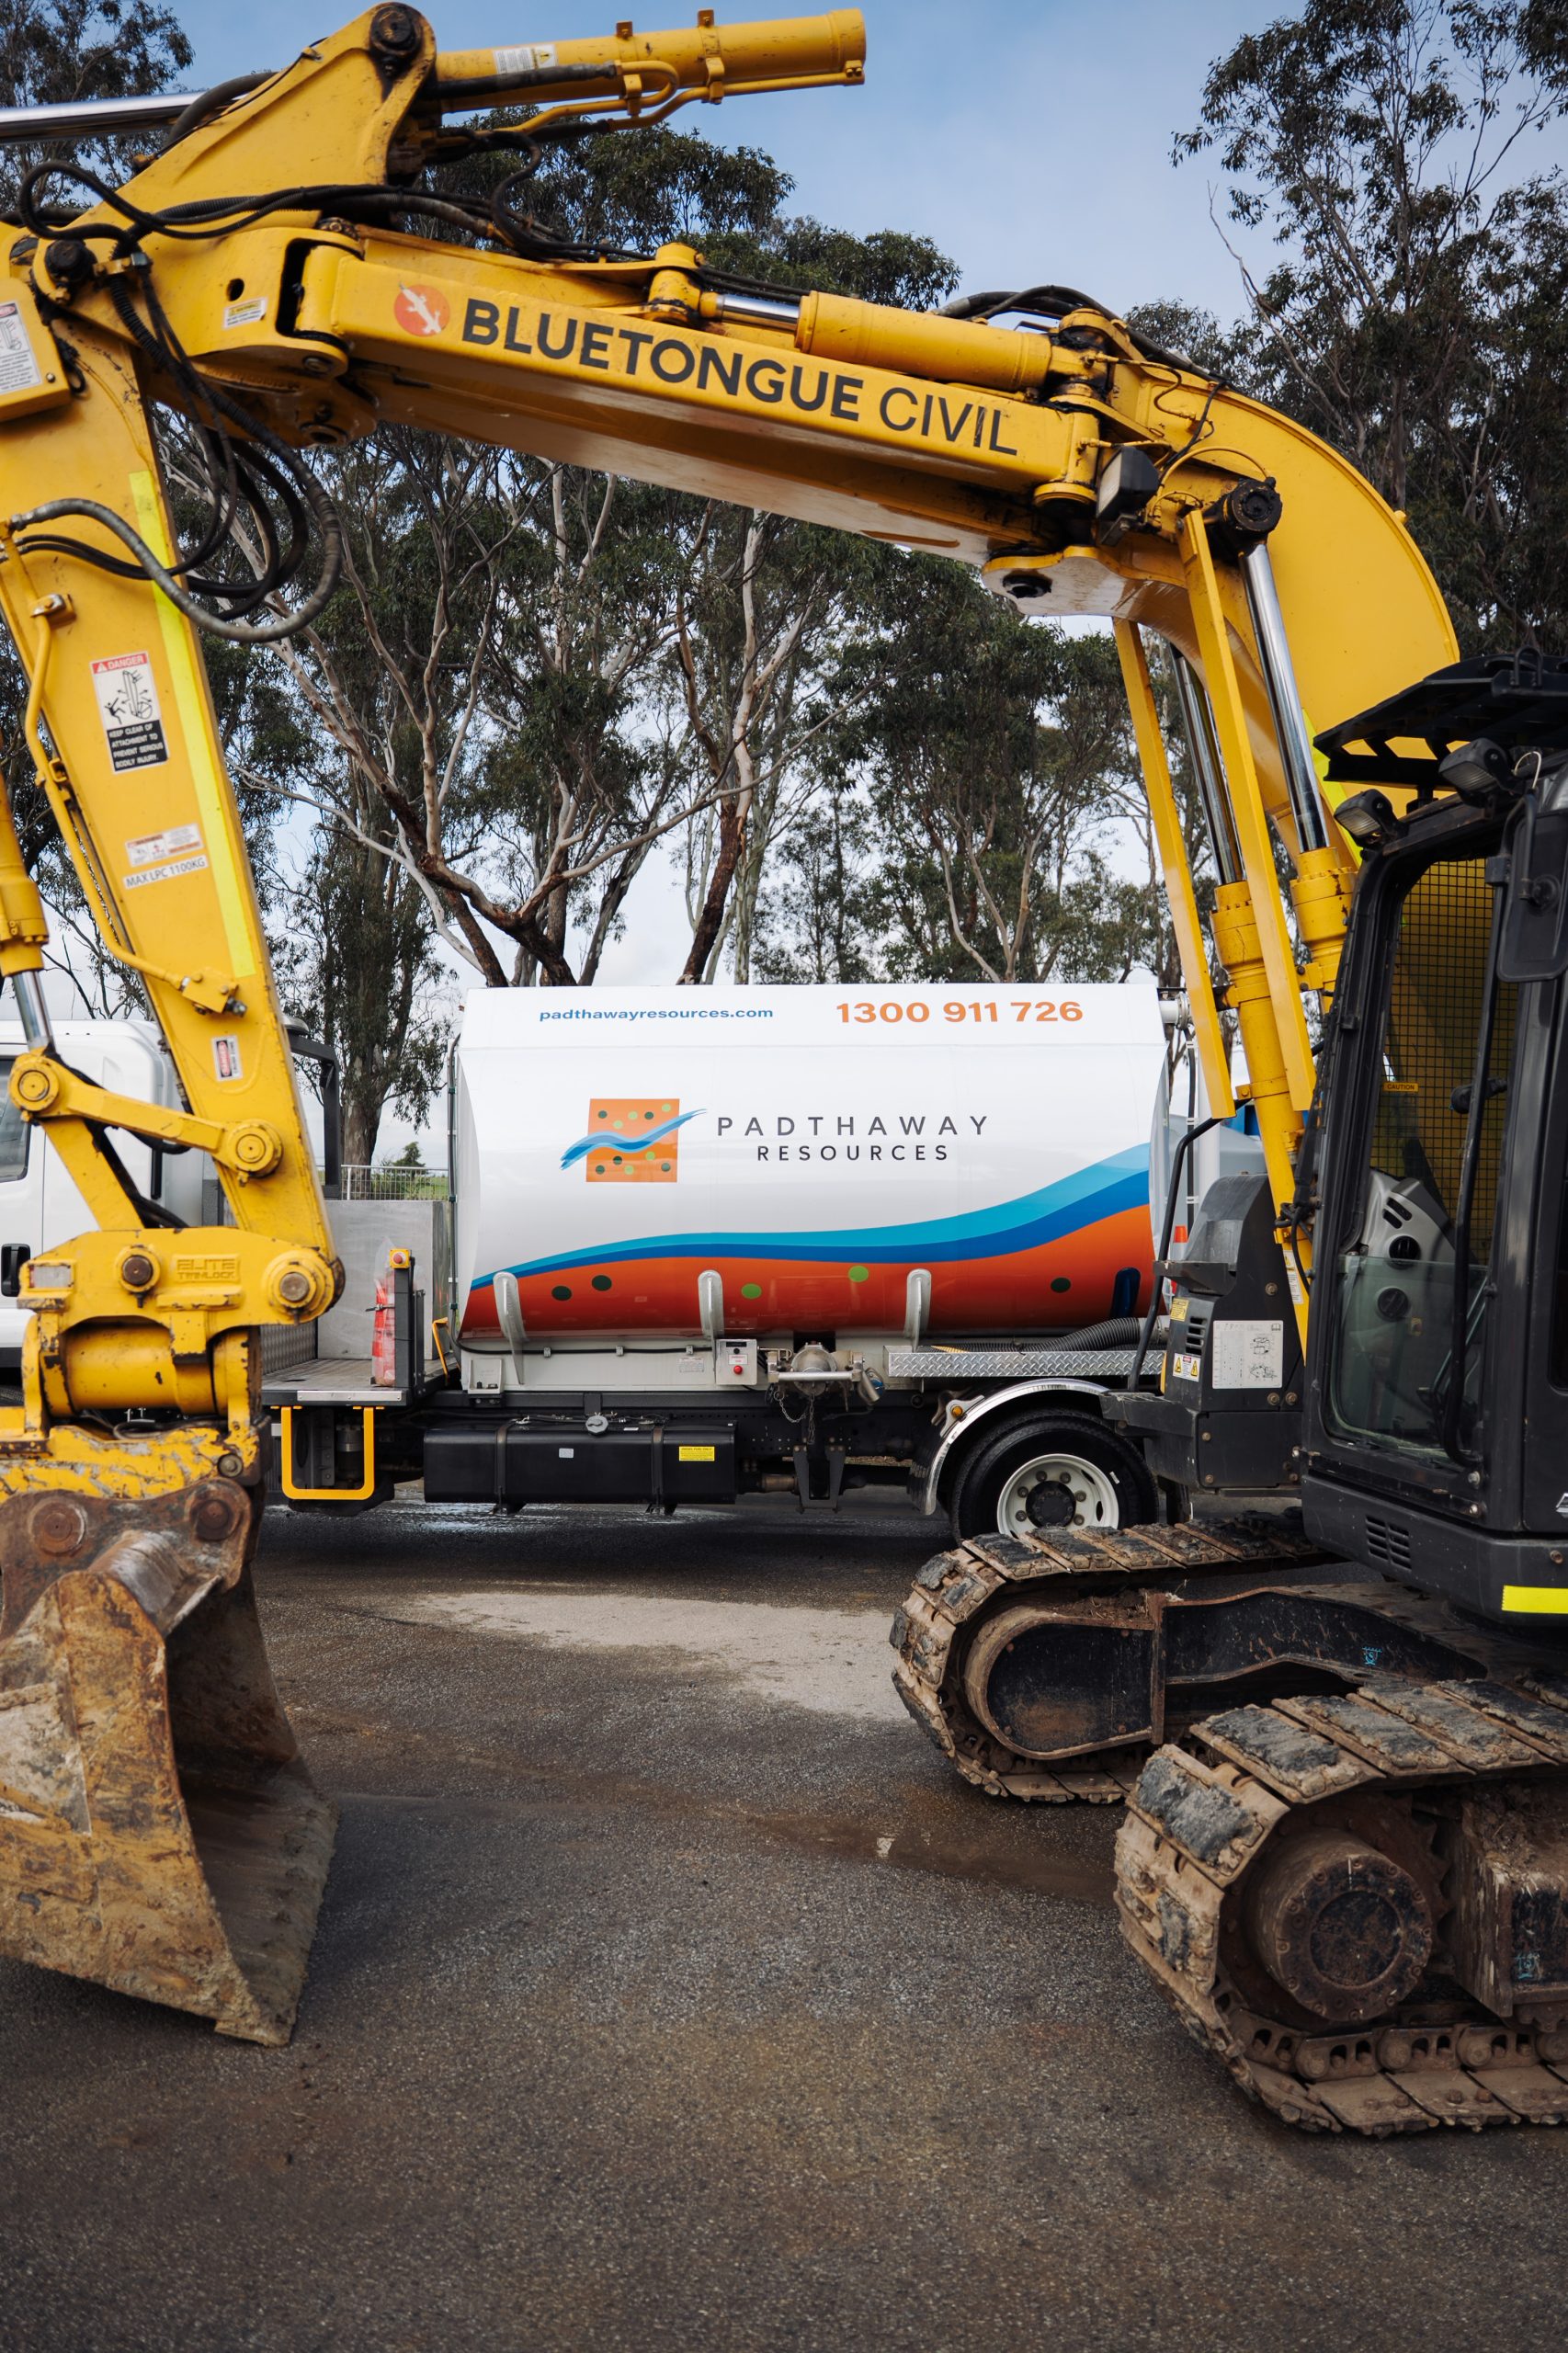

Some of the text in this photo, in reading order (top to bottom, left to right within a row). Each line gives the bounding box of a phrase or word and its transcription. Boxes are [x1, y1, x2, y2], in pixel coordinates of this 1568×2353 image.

[461, 298, 1017, 456] BLUETONGUE CIVIL
[108, 654, 143, 670] DANGER
[109, 729, 124, 738] KEEP
[125, 725, 143, 735] CLEAR
[111, 733, 158, 748] ATTACHMENT TO
[113, 742, 164, 758] PREVENT SERIOUS
[126, 874, 149, 887] MAX
[149, 868, 168, 881] LPC
[169, 857, 206, 875] 1100KG
[540, 1008, 773, 1022] padthawayresources.com
[836, 1001, 1084, 1023] 1300 911 726
[717, 1116, 987, 1136] PADTHAWAY
[757, 1144, 948, 1161] RESOURCES
[176, 1258, 235, 1270] ELITE
